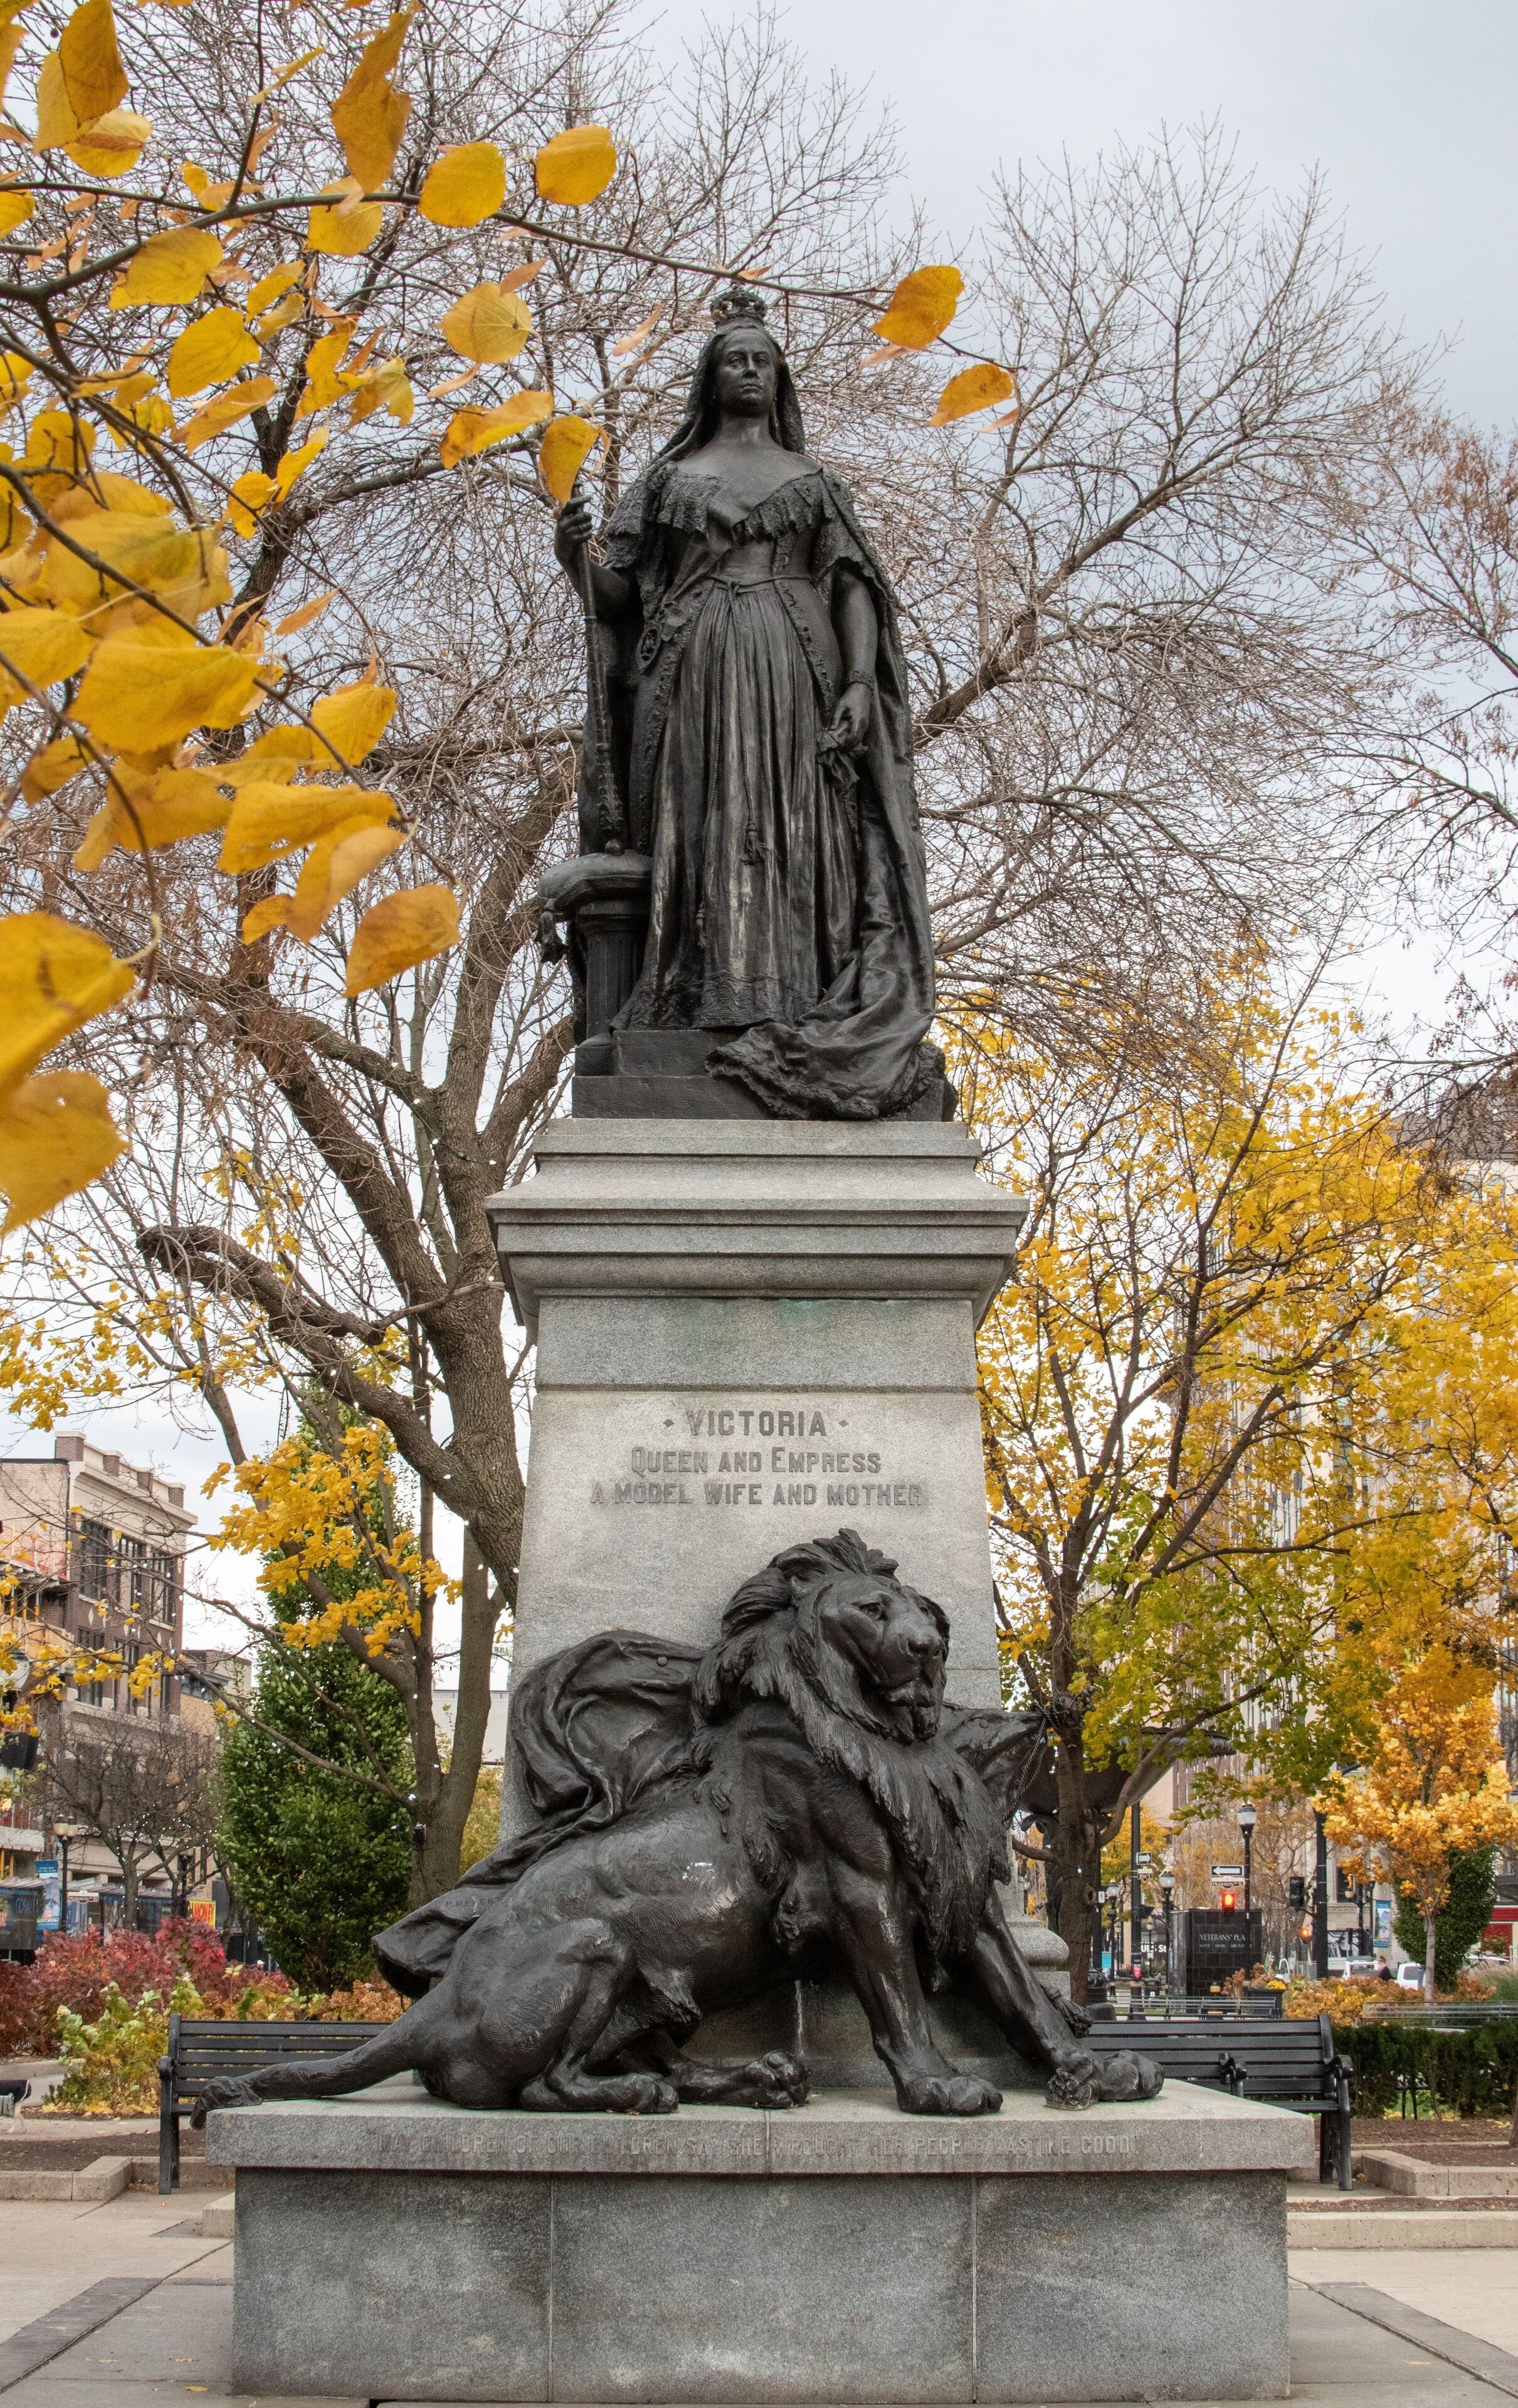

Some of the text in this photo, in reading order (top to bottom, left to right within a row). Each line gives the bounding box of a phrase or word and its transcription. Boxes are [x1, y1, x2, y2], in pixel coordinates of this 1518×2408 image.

[687, 1410, 827, 1437] VICTORIA
[631, 1446, 882, 1477] QUEEN AND EMPRESS
[590, 1482, 924, 1506] A MODEL WIFE AND MOTHER
[729, 2137, 763, 2156] SHE
